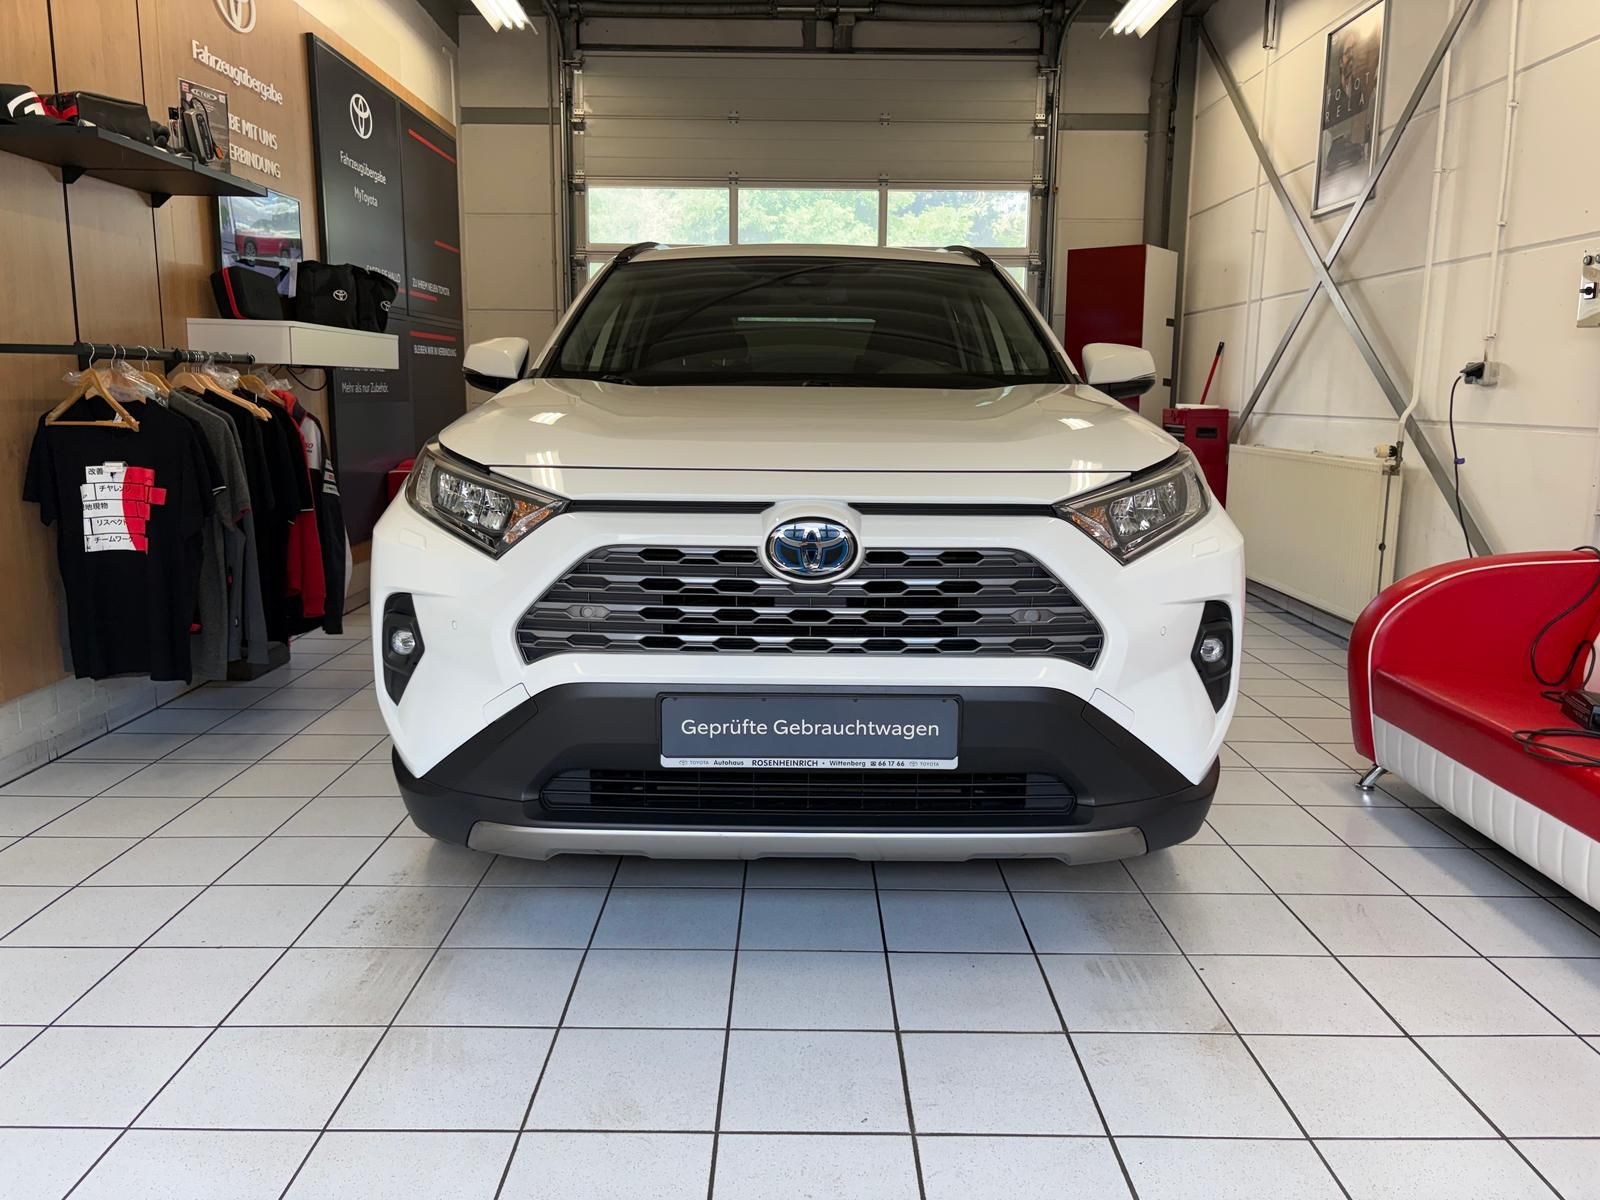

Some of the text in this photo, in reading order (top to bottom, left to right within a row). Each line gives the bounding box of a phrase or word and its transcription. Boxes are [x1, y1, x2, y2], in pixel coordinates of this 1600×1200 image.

[192, 40, 283, 105] Fahrzeugübergabe
[242, 119, 258, 141] MIT
[258, 127, 278, 150] UNS
[229, 143, 281, 178] ERBINDUNG
[340, 150, 386, 184] Fahrzeugübergabe
[354, 186, 378, 207] MyToyota
[88, 467, 103, 475] 改善
[83, 502, 109, 511] 地現物
[681, 719, 940, 740] Geprüfte Gebrauchtwagen
[751, 759, 818, 767] ROSENHEINRICH
[829, 760, 866, 768] Wittenberg
